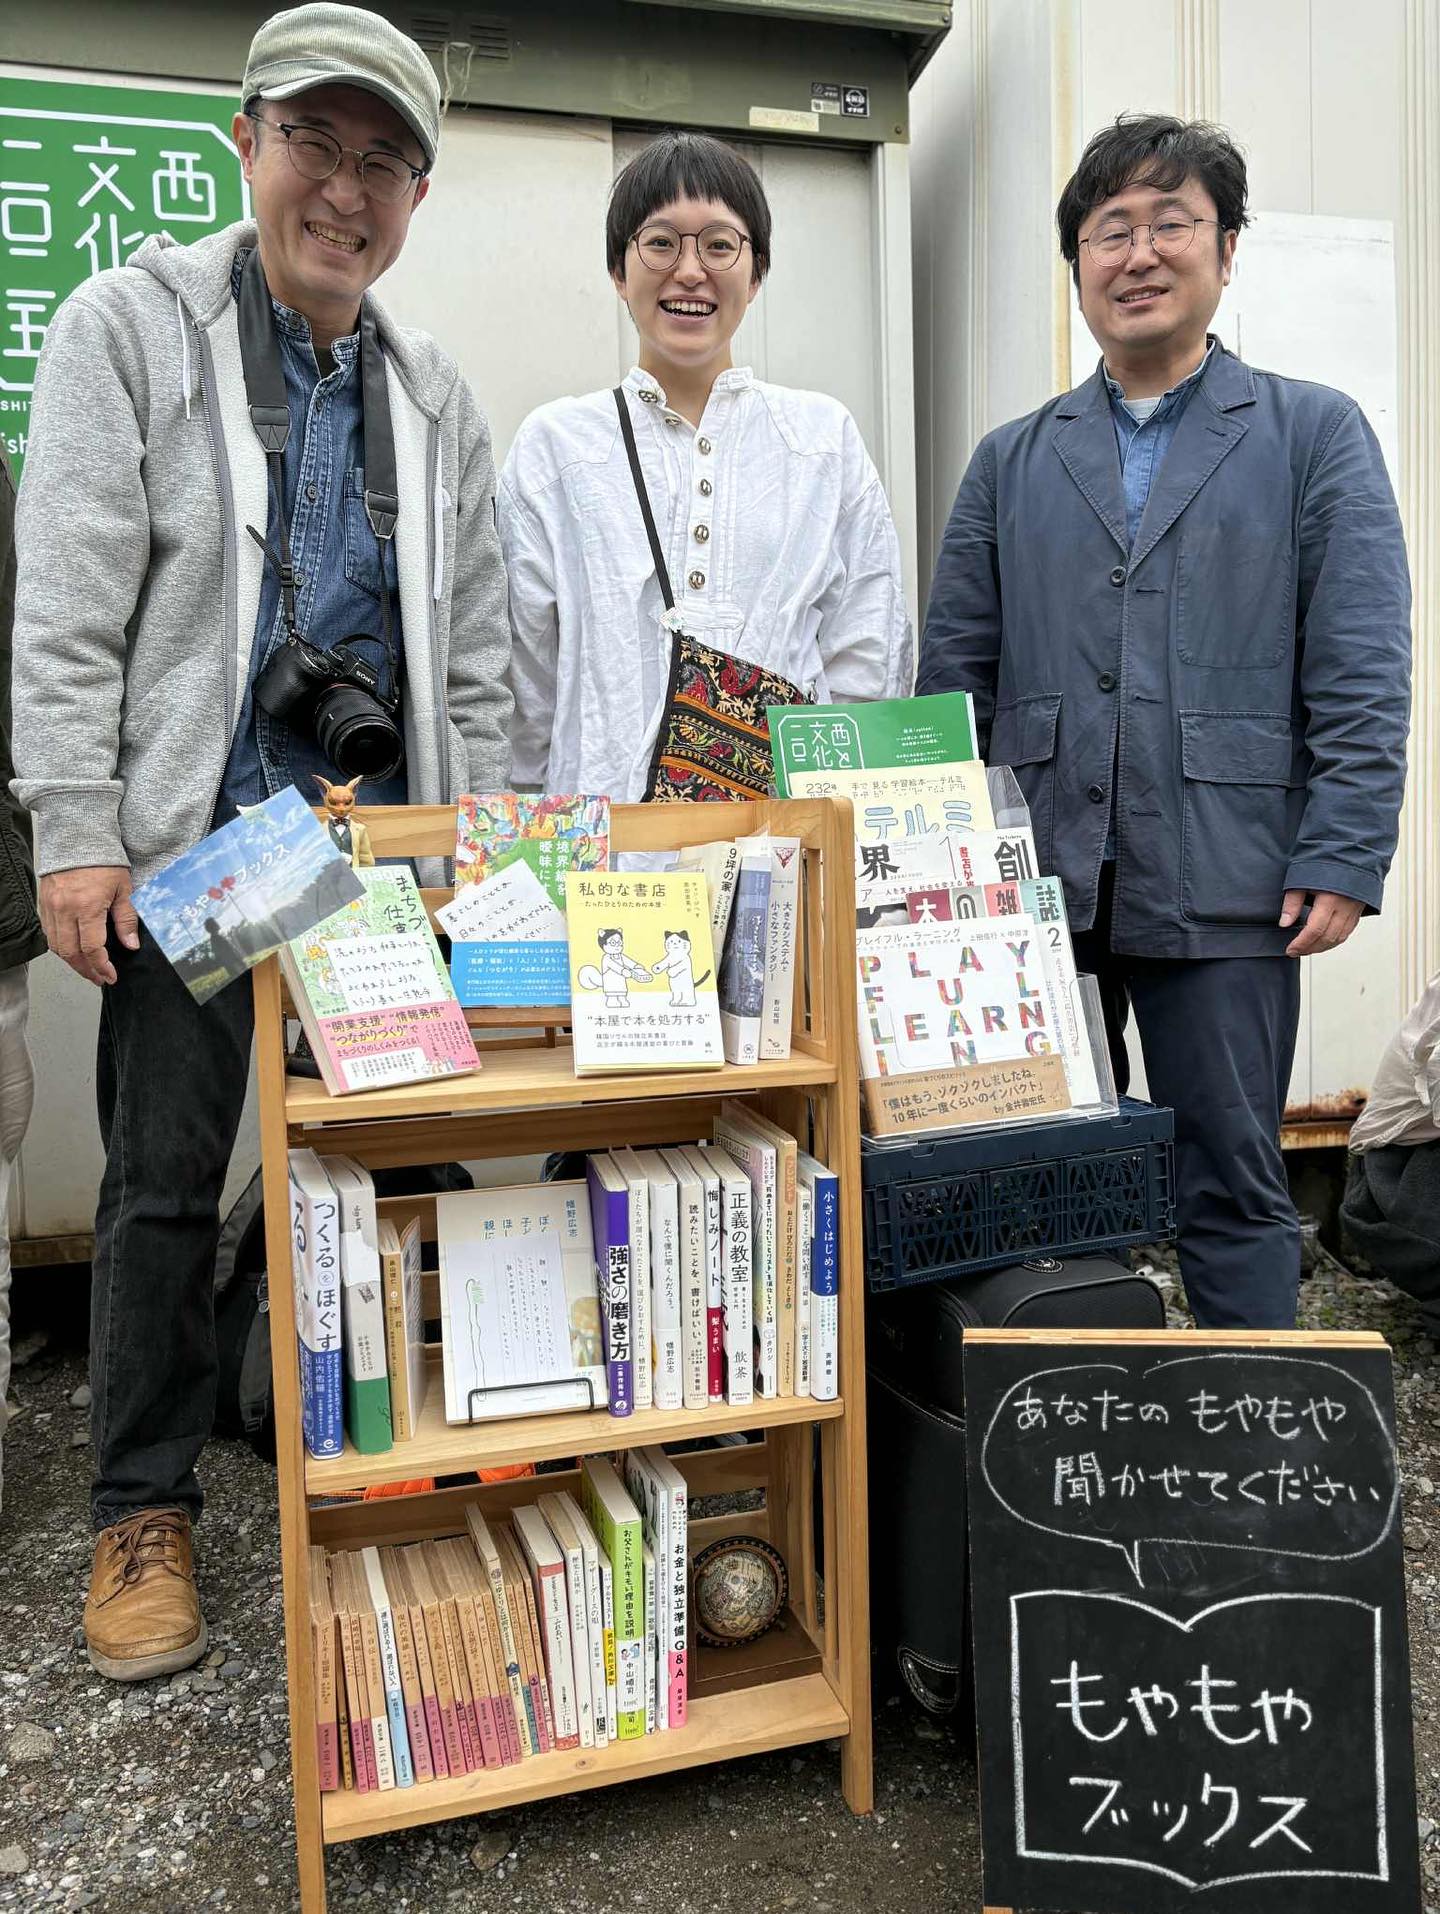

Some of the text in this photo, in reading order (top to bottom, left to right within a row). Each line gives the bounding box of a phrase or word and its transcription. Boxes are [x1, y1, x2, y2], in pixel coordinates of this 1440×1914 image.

[355, 670, 376, 686] SONY
[864, 801, 975, 839] テルミ
[578, 882, 666, 898] 私的な書店
[860, 844, 900, 882] 界
[994, 839, 1034, 882] 創
[769, 902, 781, 982] 小さなファンタジー
[780, 902, 793, 973] 大きなシステムと
[1047, 926, 1062, 948] 2
[707, 1189, 720, 1288] 悔しみノート
[729, 1191, 750, 1284] 正義の教室
[822, 1190, 835, 1295] 小さくはじめよう
[609, 1246, 630, 1361] 強さの磨き方
[688, 1204, 702, 1346] 読みたいことを、書けばいい。
[733, 1350, 749, 1379] 飲茶
[1014, 1386, 1347, 1442] あなたの もやもや
[1053, 1451, 1380, 1506] 聞かせてください
[623, 1529, 636, 1638] お父さんがキモい理由を説明
[1050, 1660, 1312, 1745] もやもや
[1069, 1772, 1312, 1853] ブックス
